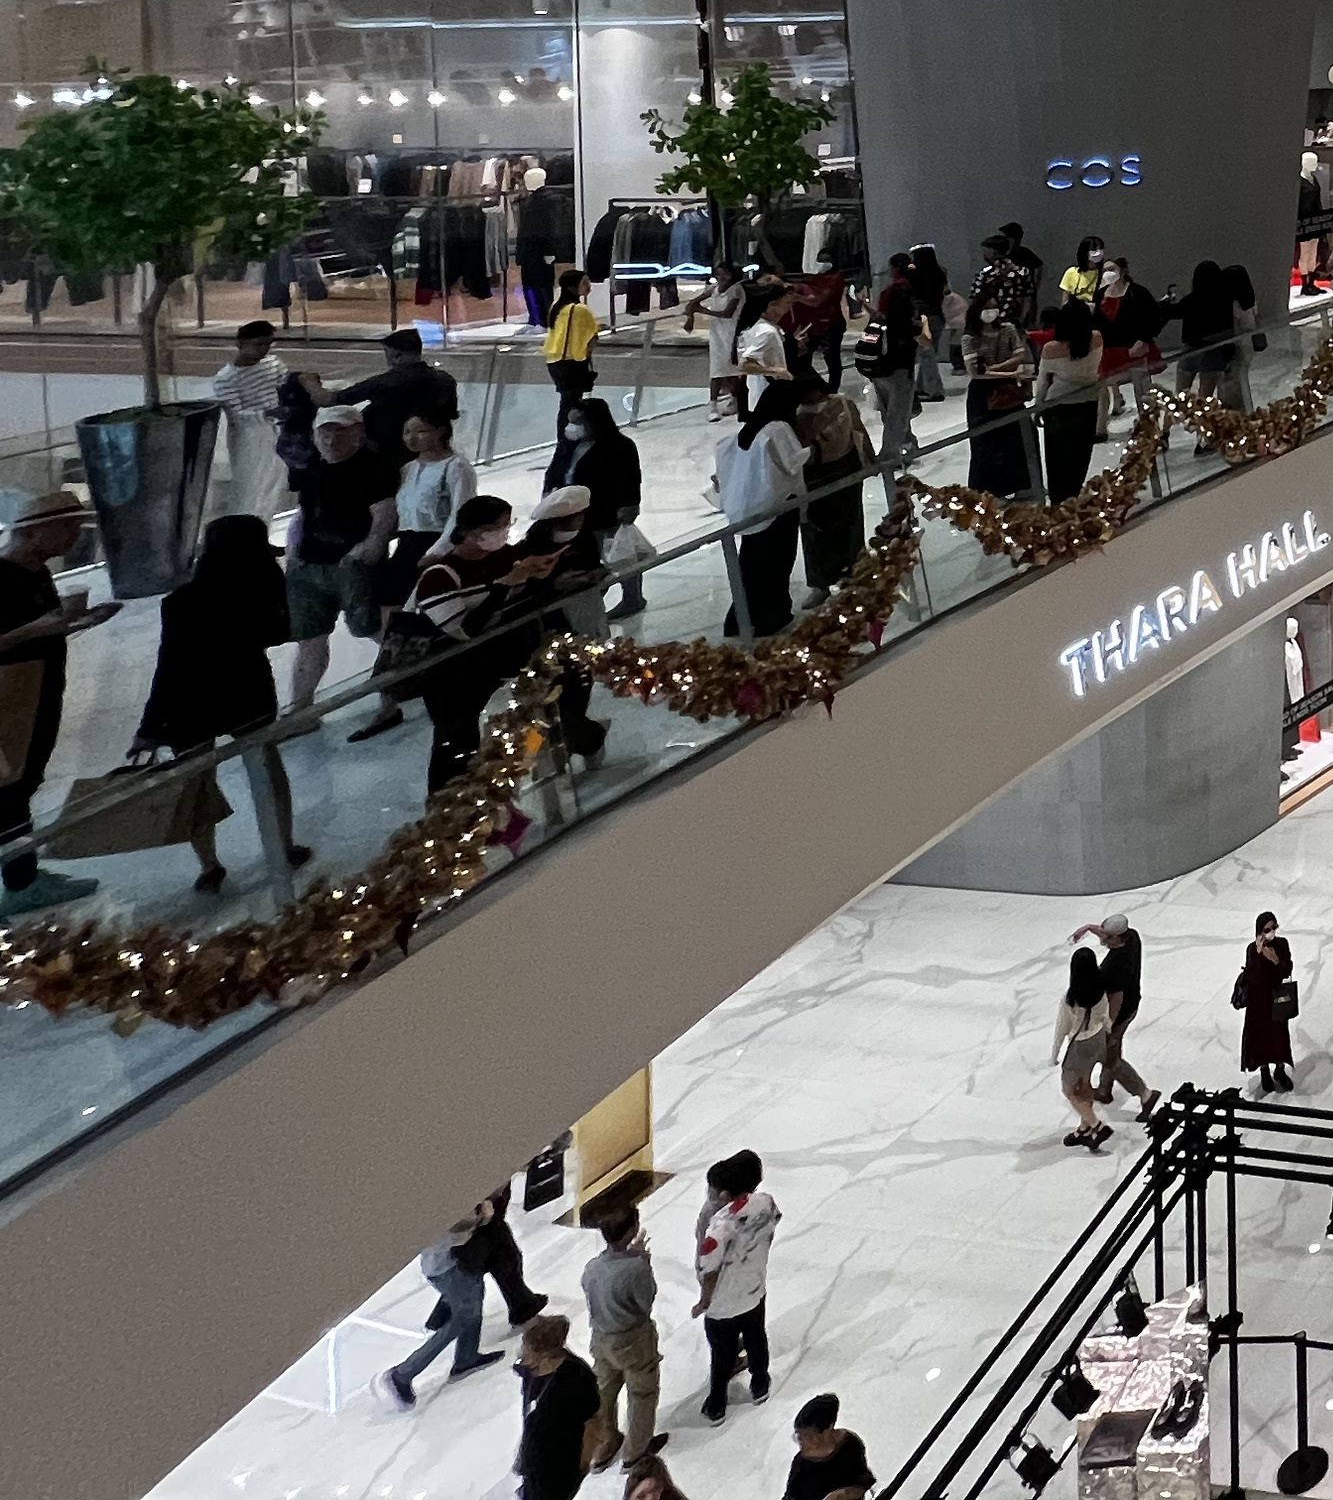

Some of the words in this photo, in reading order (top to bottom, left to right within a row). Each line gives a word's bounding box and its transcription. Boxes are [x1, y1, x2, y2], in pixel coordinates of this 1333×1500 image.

[1045, 155, 1142, 190] COS
[1060, 569, 1224, 697] THARA
[1226, 509, 1333, 598] HALL
